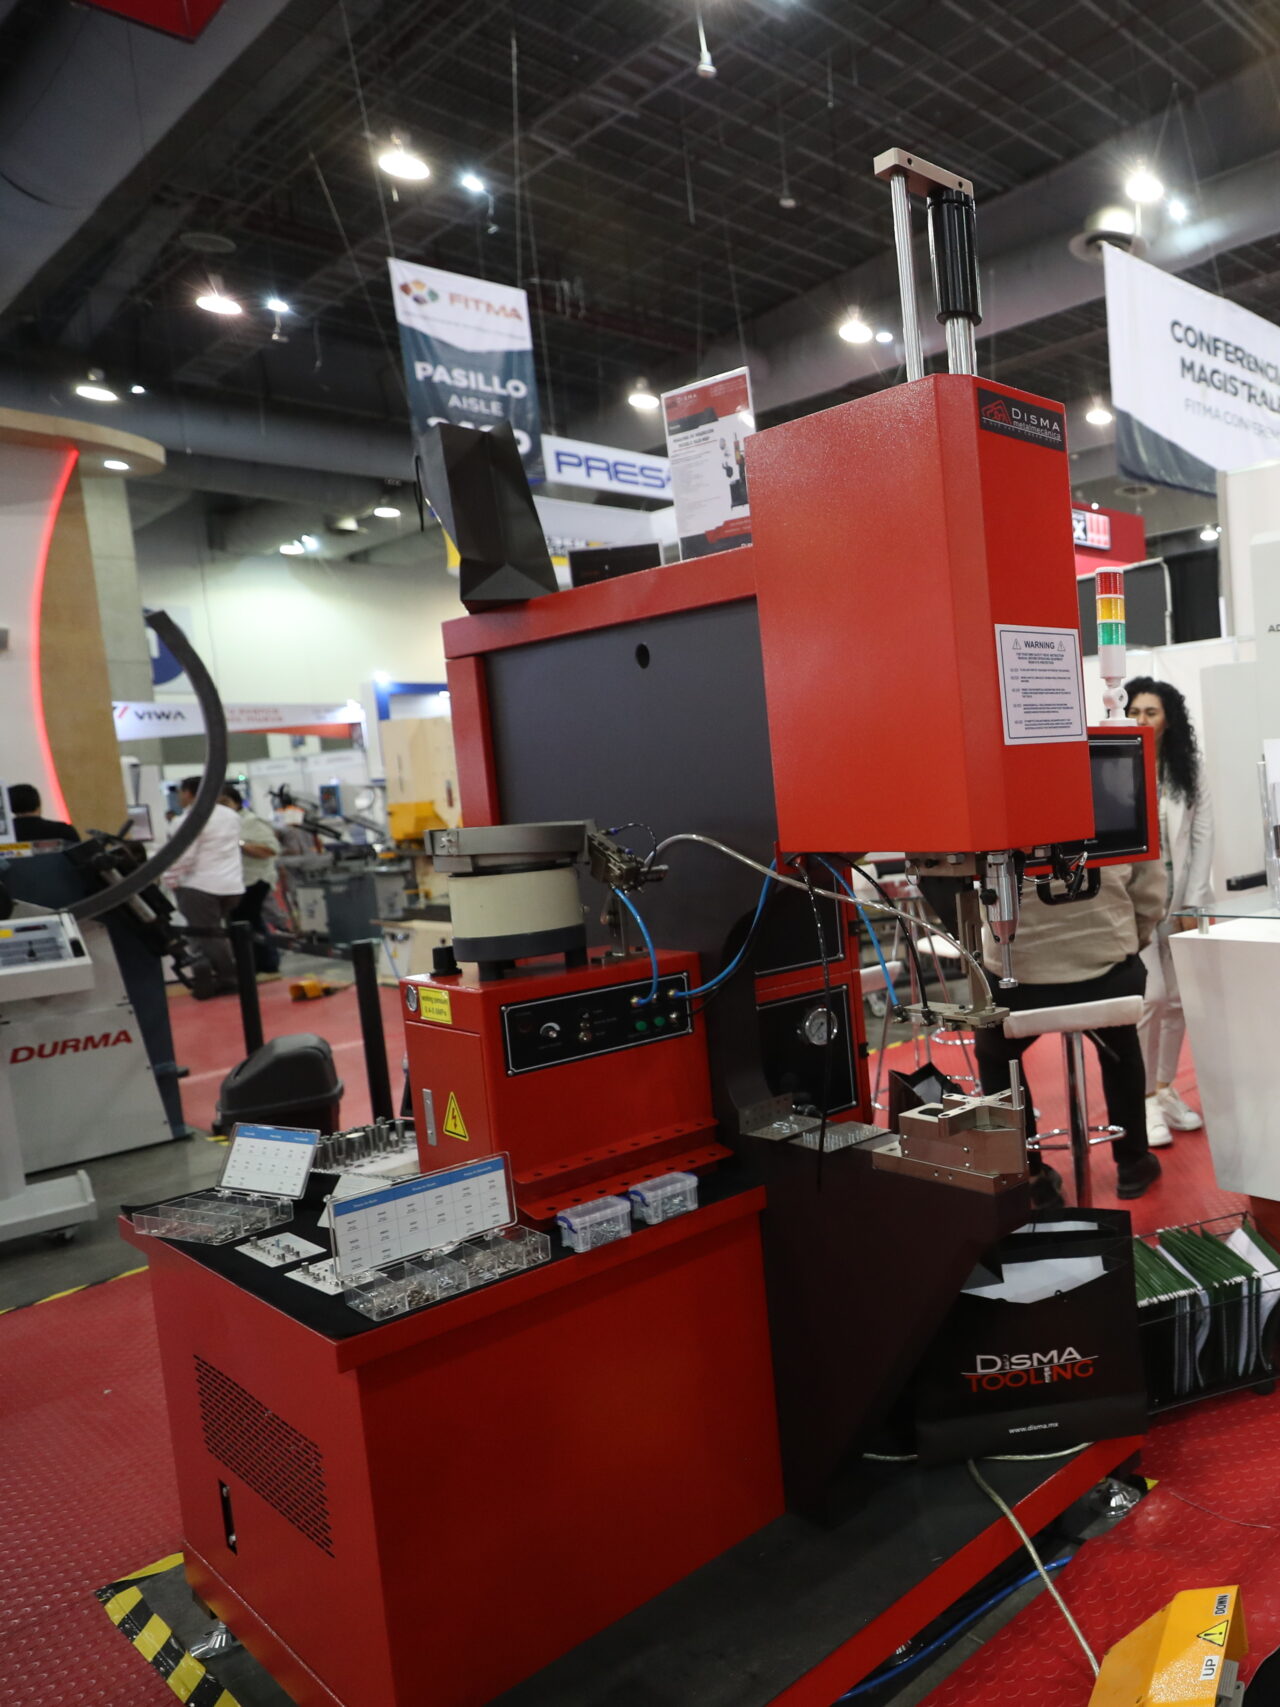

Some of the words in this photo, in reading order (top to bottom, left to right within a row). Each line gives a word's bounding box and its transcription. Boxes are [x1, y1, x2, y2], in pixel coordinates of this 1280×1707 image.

[448, 292, 523, 321] FITMA
[413, 361, 527, 399] PASILLO
[448, 394, 504, 417] AISLE
[1011, 407, 1060, 432] DISMA
[1024, 640, 1055, 650] WARNING
[134, 710, 186, 721] VIWA
[9, 1029, 133, 1065] DURMA
[964, 1359, 1095, 1393] TOOLING
[1008, 1422, 1059, 1434] www.disma.mx
[1214, 1594, 1229, 1615] DOWN
[1202, 1658, 1216, 1677] UP
